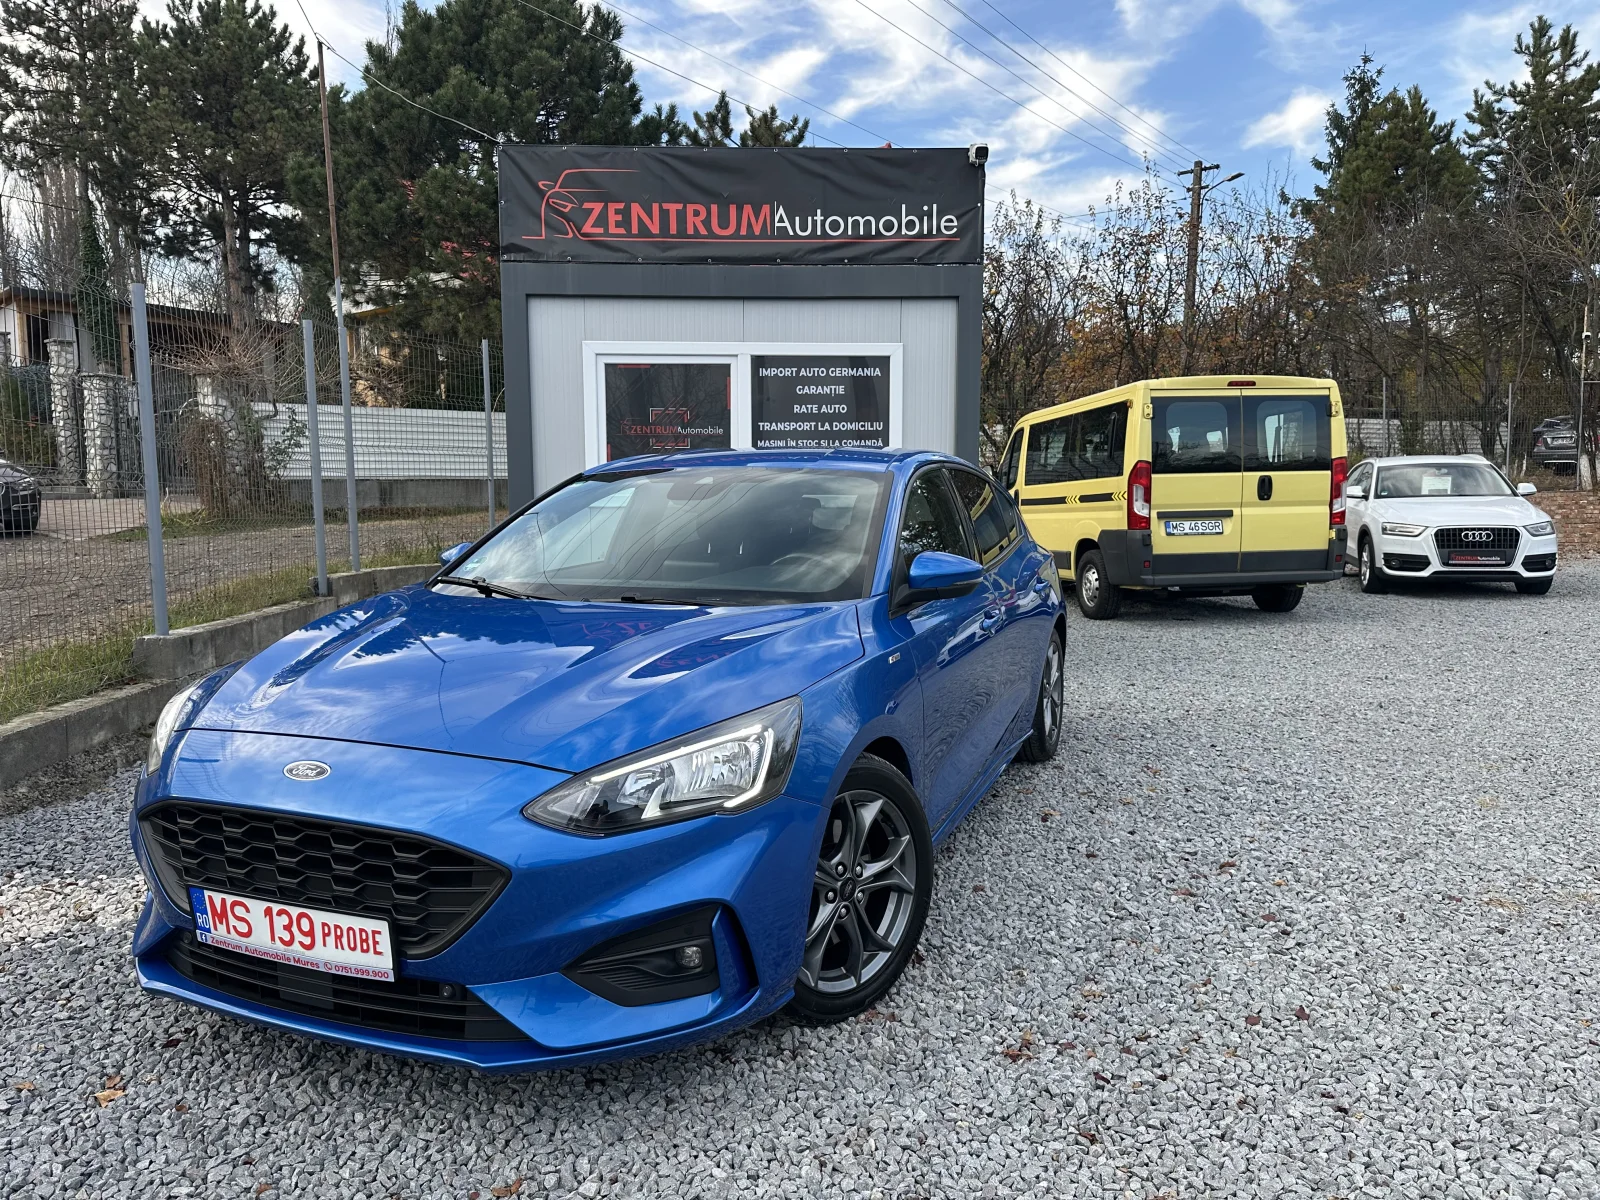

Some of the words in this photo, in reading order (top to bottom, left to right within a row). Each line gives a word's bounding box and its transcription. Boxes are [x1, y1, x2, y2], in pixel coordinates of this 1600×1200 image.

[580, 202, 771, 236] ZENTRUM
[775, 203, 958, 236] Automobile
[759, 367, 797, 377] IMPORT
[799, 367, 827, 377] AUTO
[828, 367, 882, 377] GERMANIA
[793, 404, 819, 414] RATE
[820, 404, 848, 414] AUTO
[631, 425, 677, 434] ZENTRUM
[677, 425, 724, 435] Automobile
[758, 422, 816, 431] TRANSPORT
[818, 422, 831, 431] LA
[832, 421, 883, 431] DOMICILIU
[797, 439, 819, 447] STOC
[829, 439, 840, 447] LA
[1171, 522, 1186, 532] MS
[292, 764, 321, 777] Ford
[196, 912, 210, 929] RO
[207, 894, 253, 939] MS
[263, 905, 316, 951] 139
[320, 921, 384, 956] PROBE
[210, 936, 243, 952] Zentrum
[244, 944, 292, 963] Automobile
[293, 956, 320, 969] Mures
[334, 964, 390, 979] 0751.999.900
